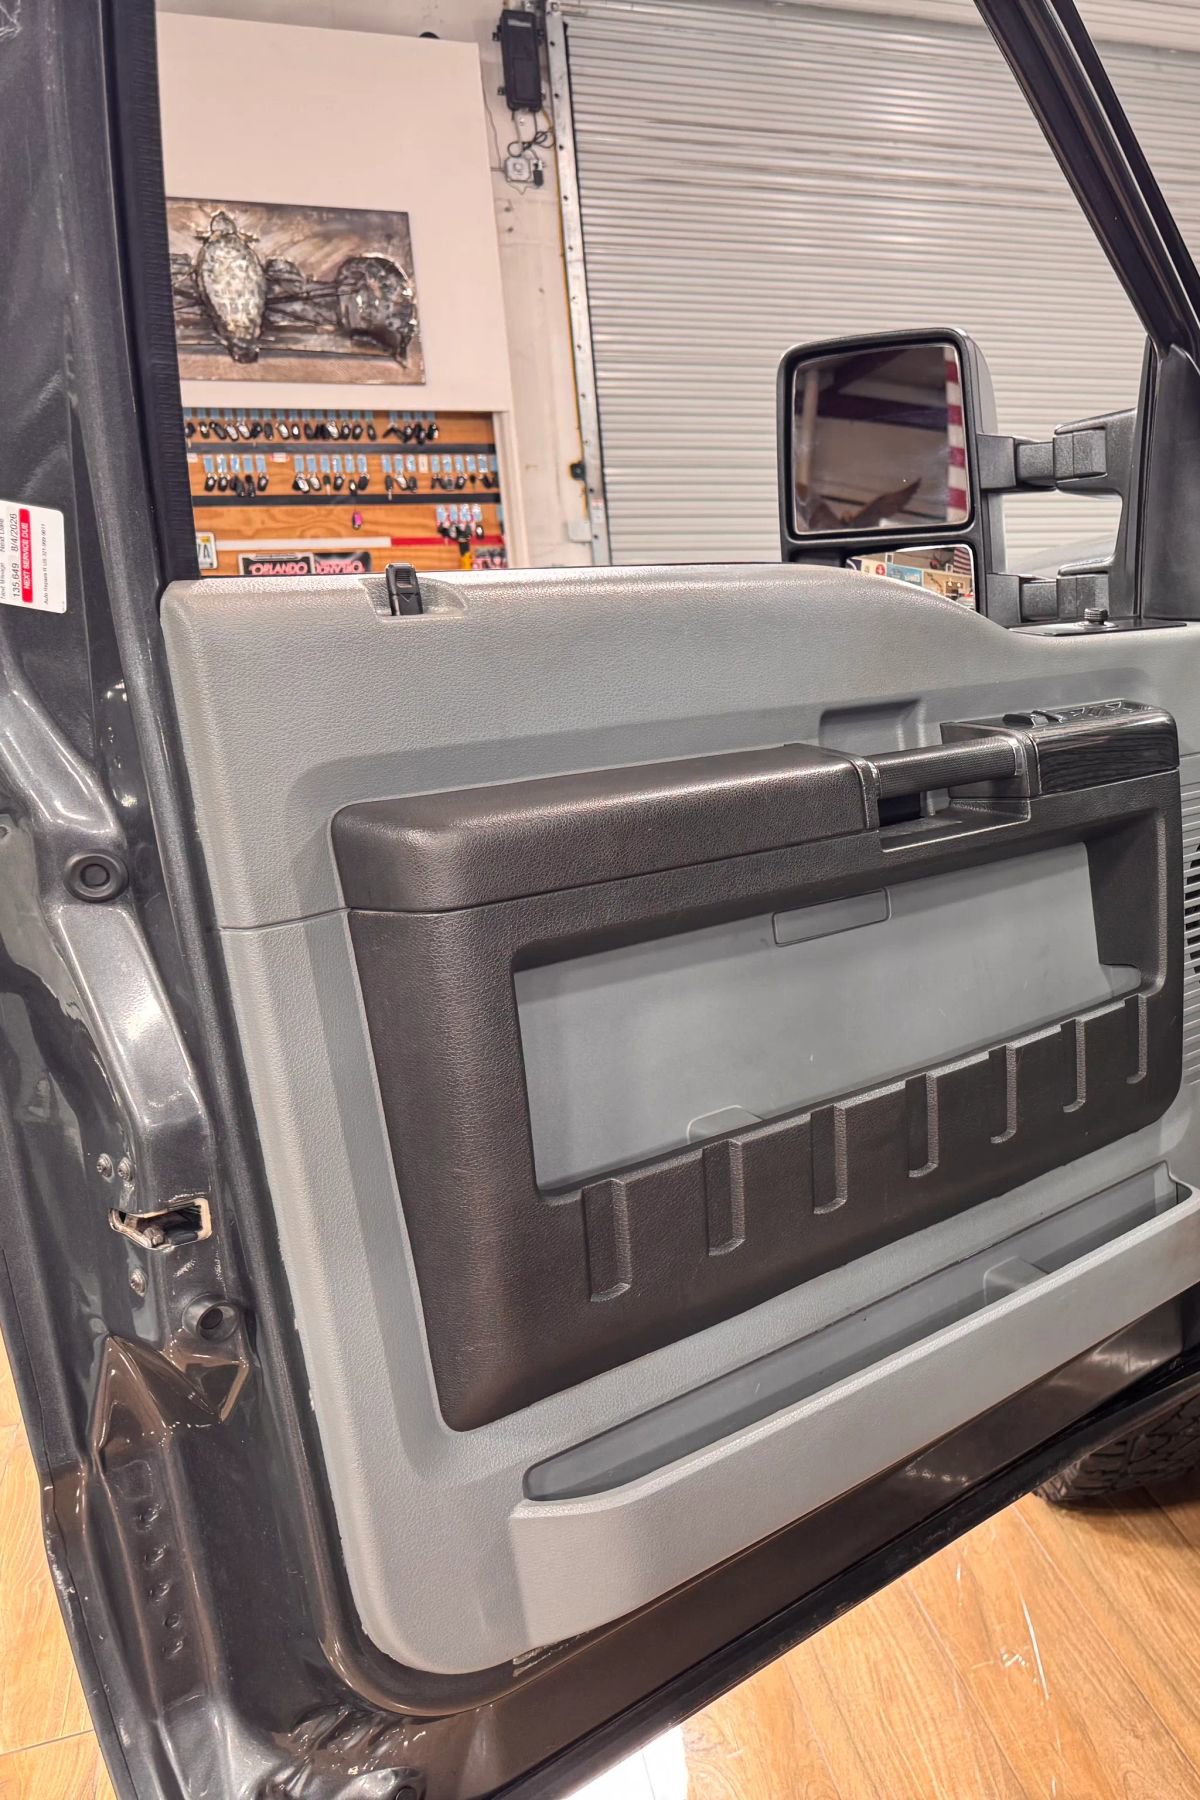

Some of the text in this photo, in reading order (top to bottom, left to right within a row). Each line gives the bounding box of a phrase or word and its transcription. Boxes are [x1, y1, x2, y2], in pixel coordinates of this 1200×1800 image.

[21, 522, 31, 589] NEXT SERVICE DUE
[250, 561, 308, 574] ORLANDO
